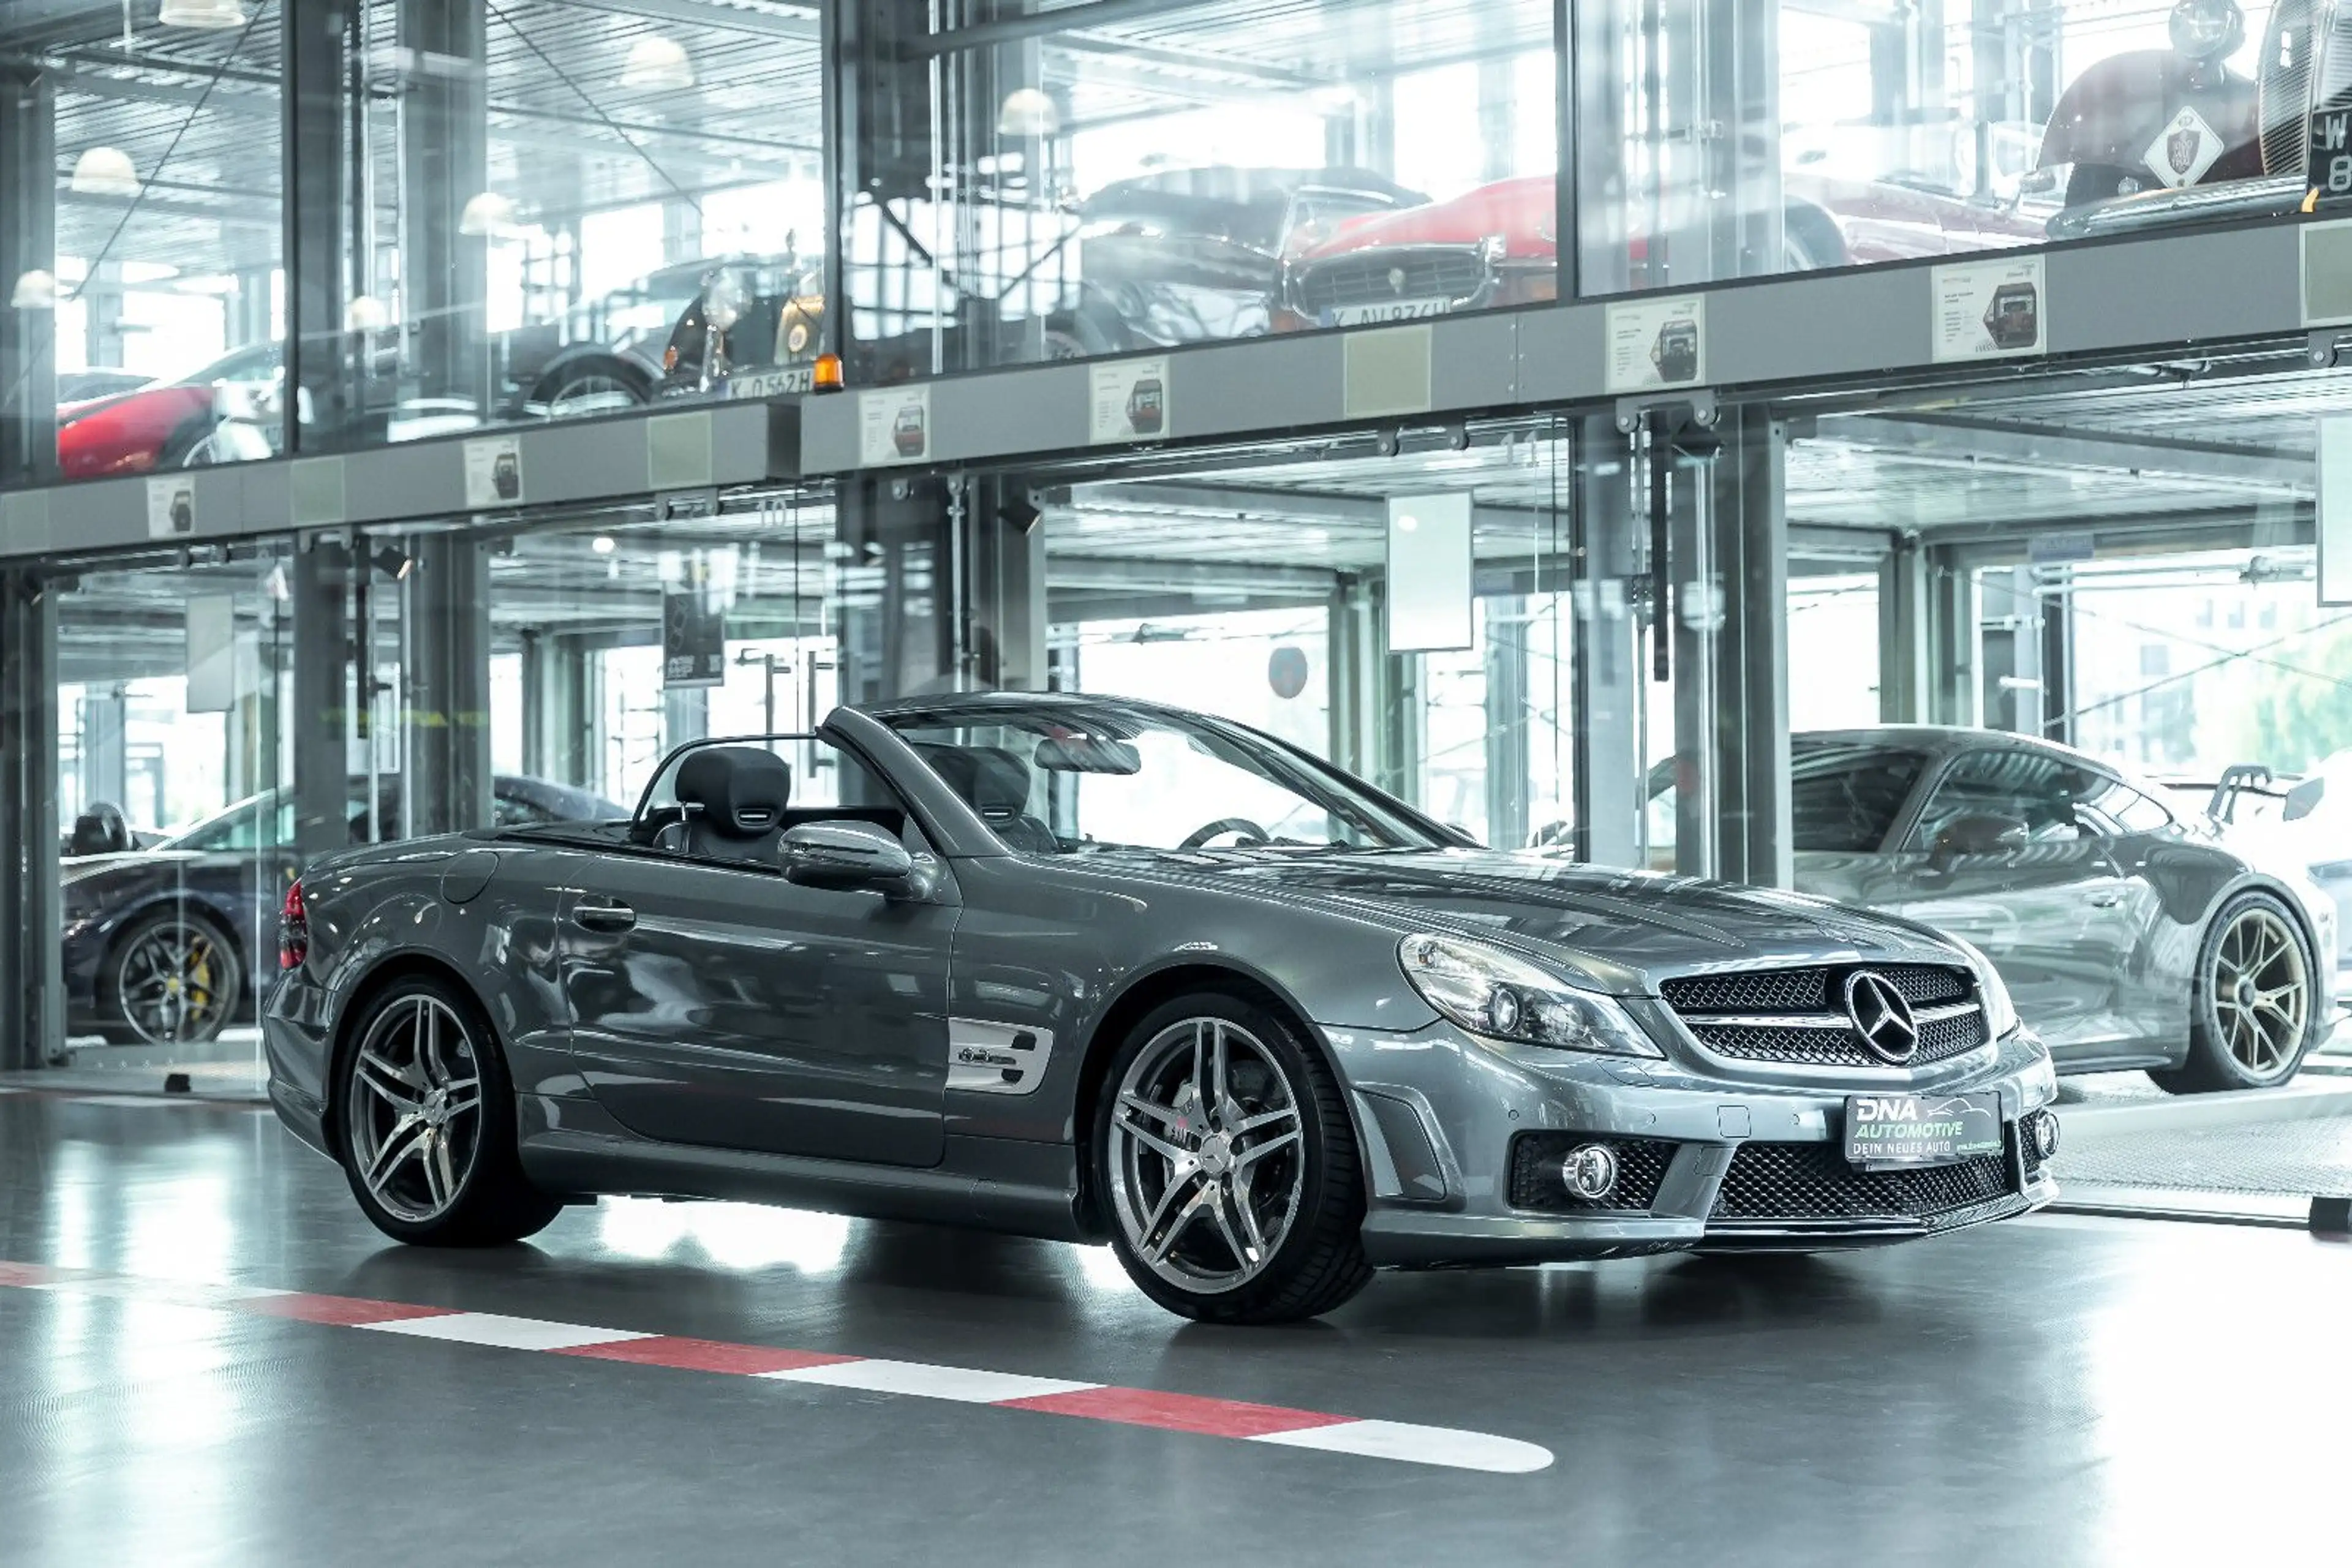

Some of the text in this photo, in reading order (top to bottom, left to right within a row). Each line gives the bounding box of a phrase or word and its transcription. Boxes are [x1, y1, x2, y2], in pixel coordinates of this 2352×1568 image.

[1856, 1099, 1918, 1121] DNA
[1854, 1121, 1964, 1139] AUTOMOTIVE
[1853, 1143, 1881, 1155] DEIN
[1887, 1142, 1923, 1154] NEUES
[1926, 1140, 1950, 1152] AUTO
